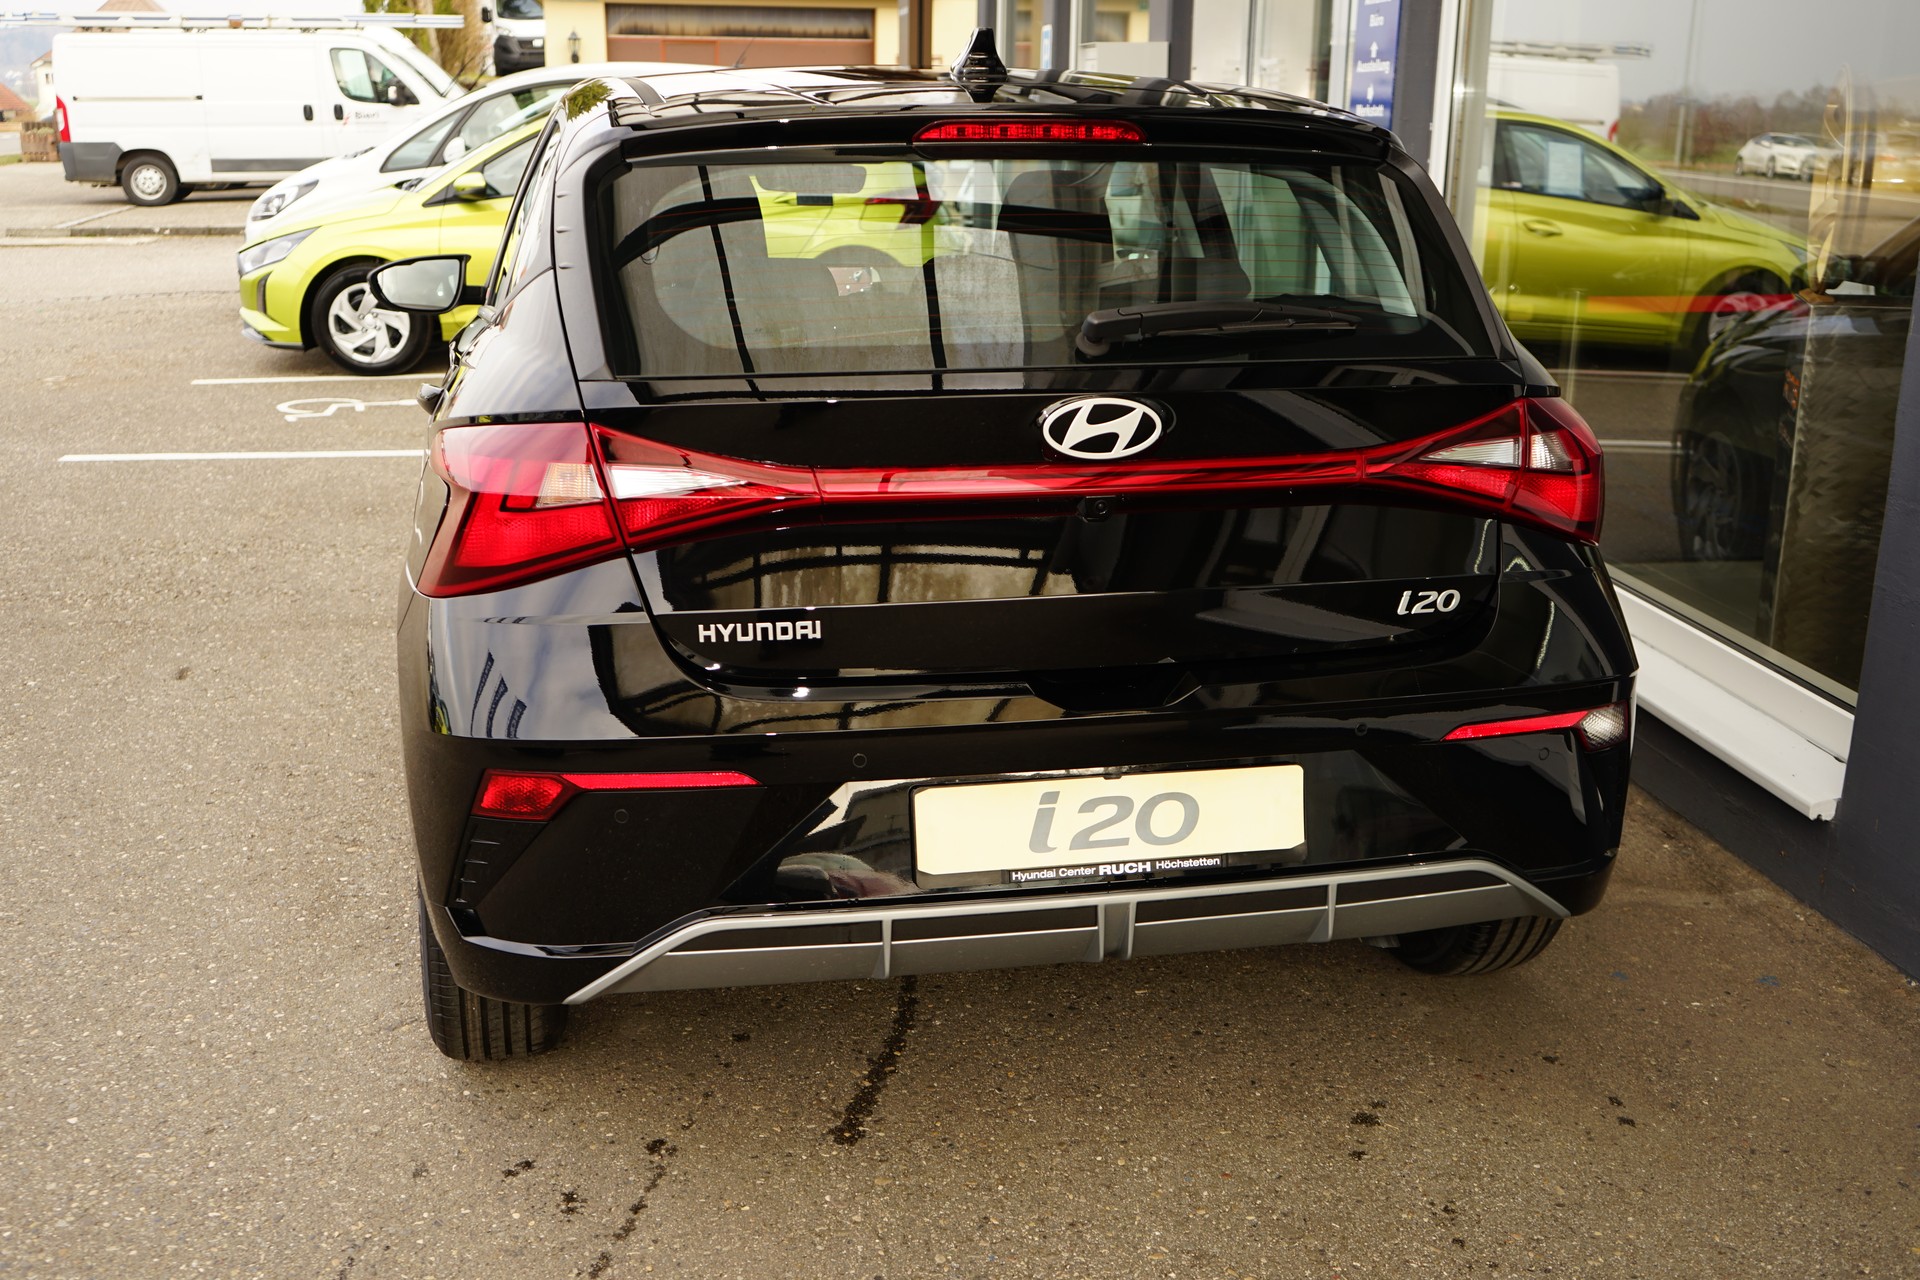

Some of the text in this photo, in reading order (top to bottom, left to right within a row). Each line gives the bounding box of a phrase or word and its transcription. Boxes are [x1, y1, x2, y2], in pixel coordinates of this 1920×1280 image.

[1397, 589, 1461, 615] i20
[698, 620, 821, 643] HYUNDAI
[1011, 856, 1220, 882] Hyundai Center RUCH Höchstetten
